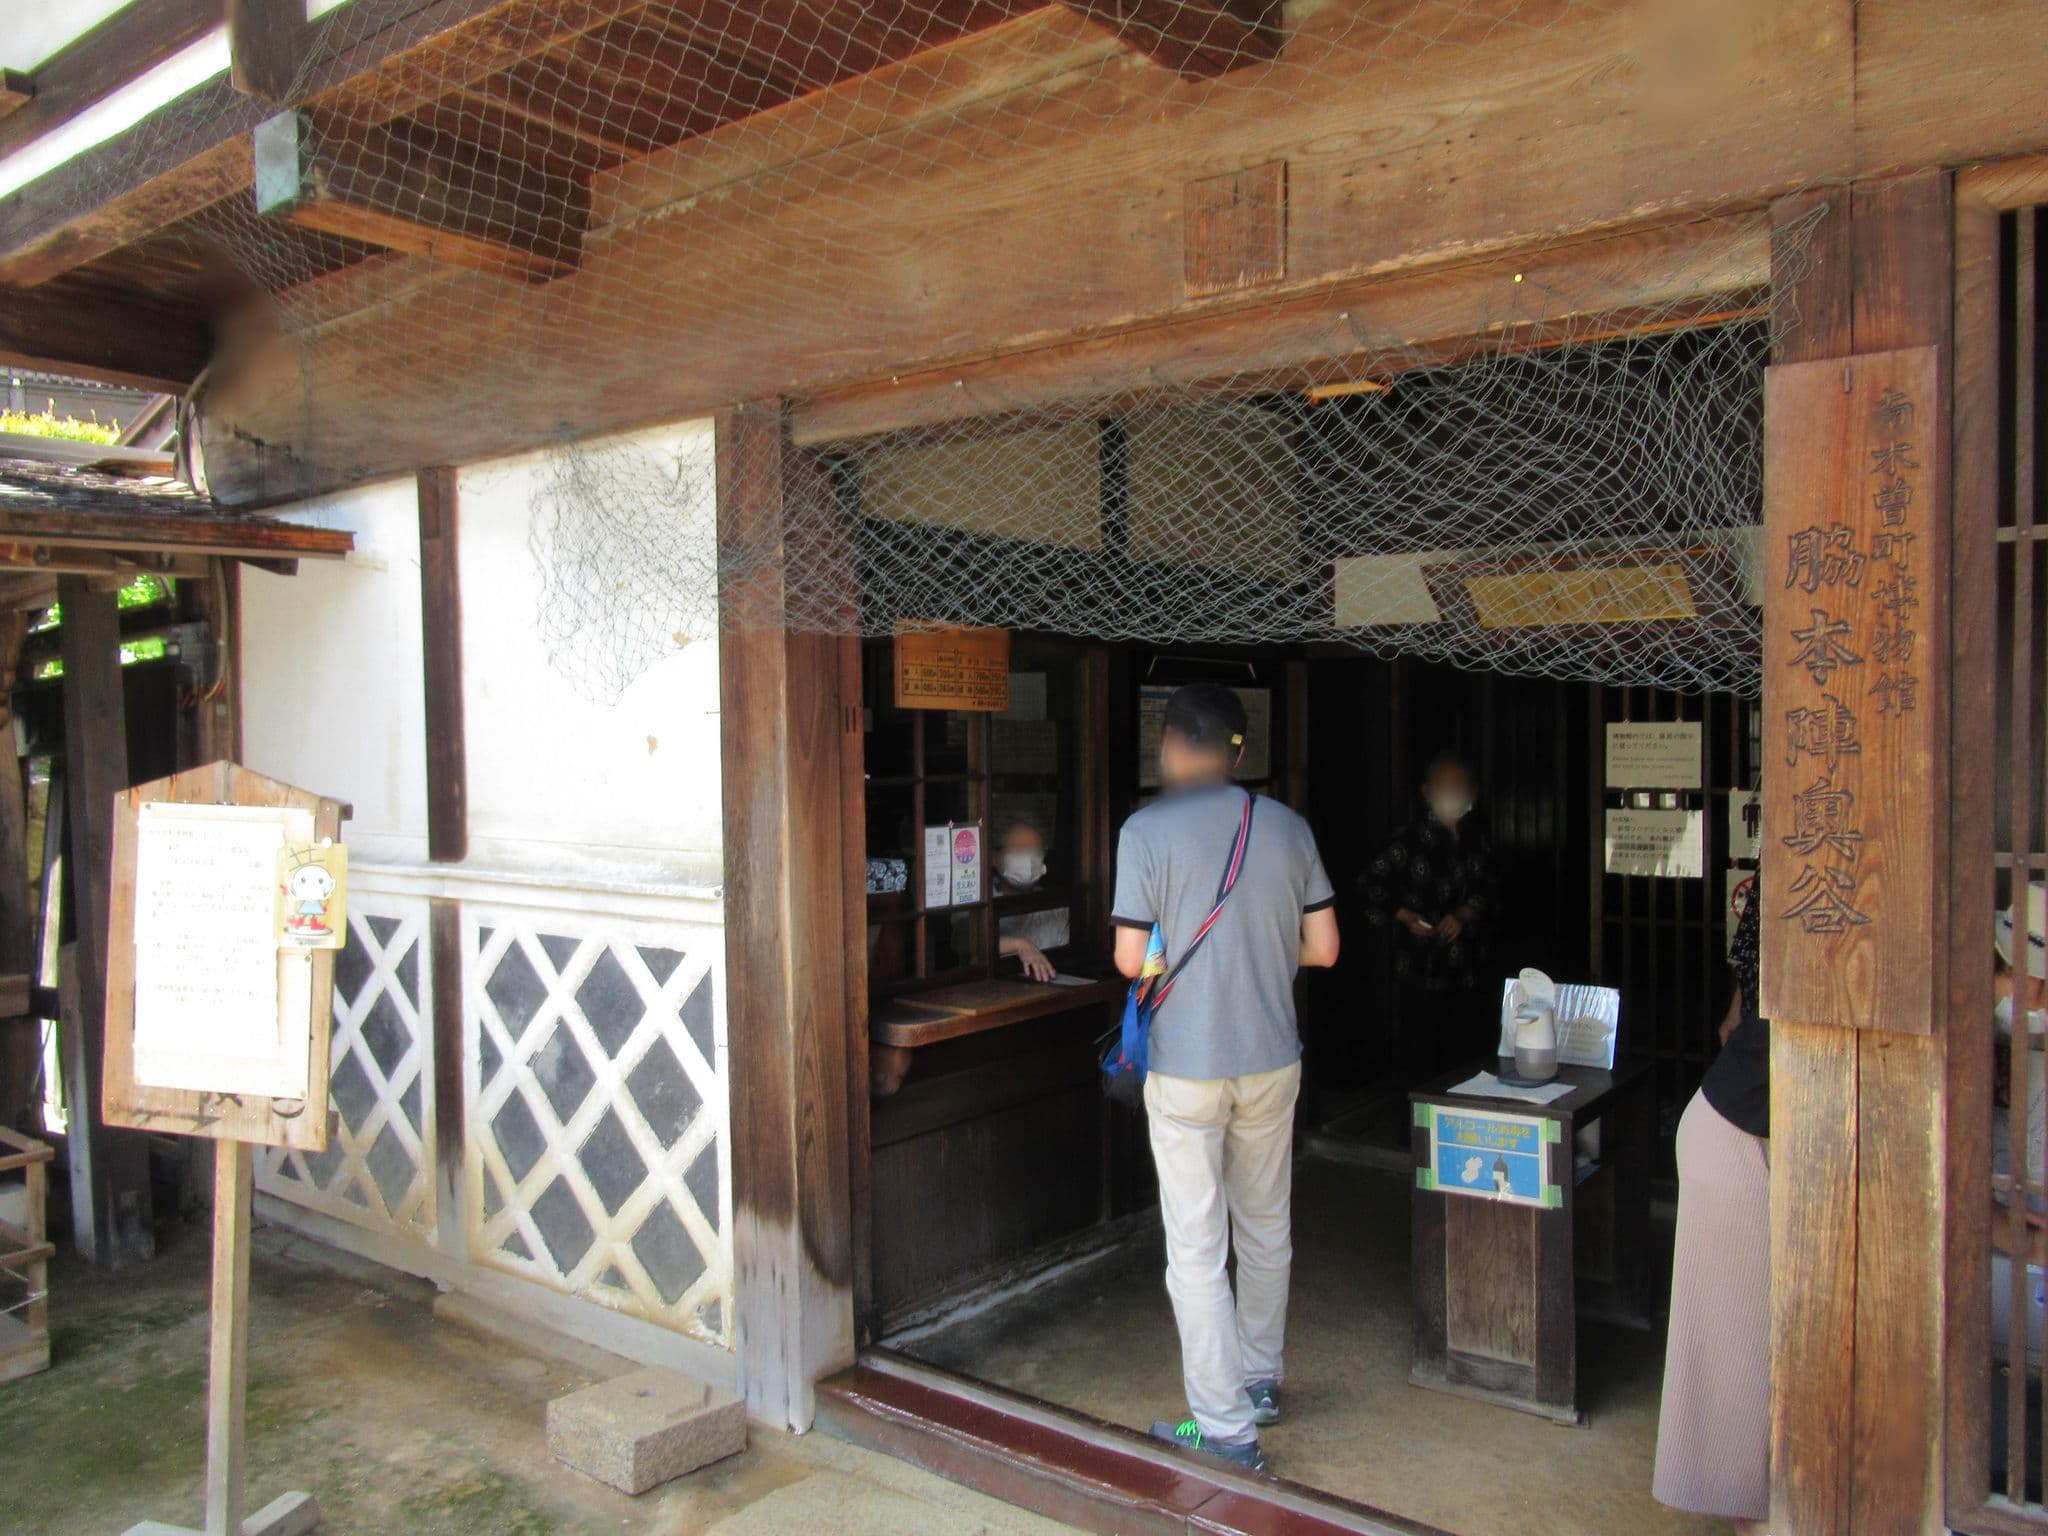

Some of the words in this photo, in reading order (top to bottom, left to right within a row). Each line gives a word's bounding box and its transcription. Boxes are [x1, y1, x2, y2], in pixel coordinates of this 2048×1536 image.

[1780, 522, 1872, 934] 脇本陣奥谷
